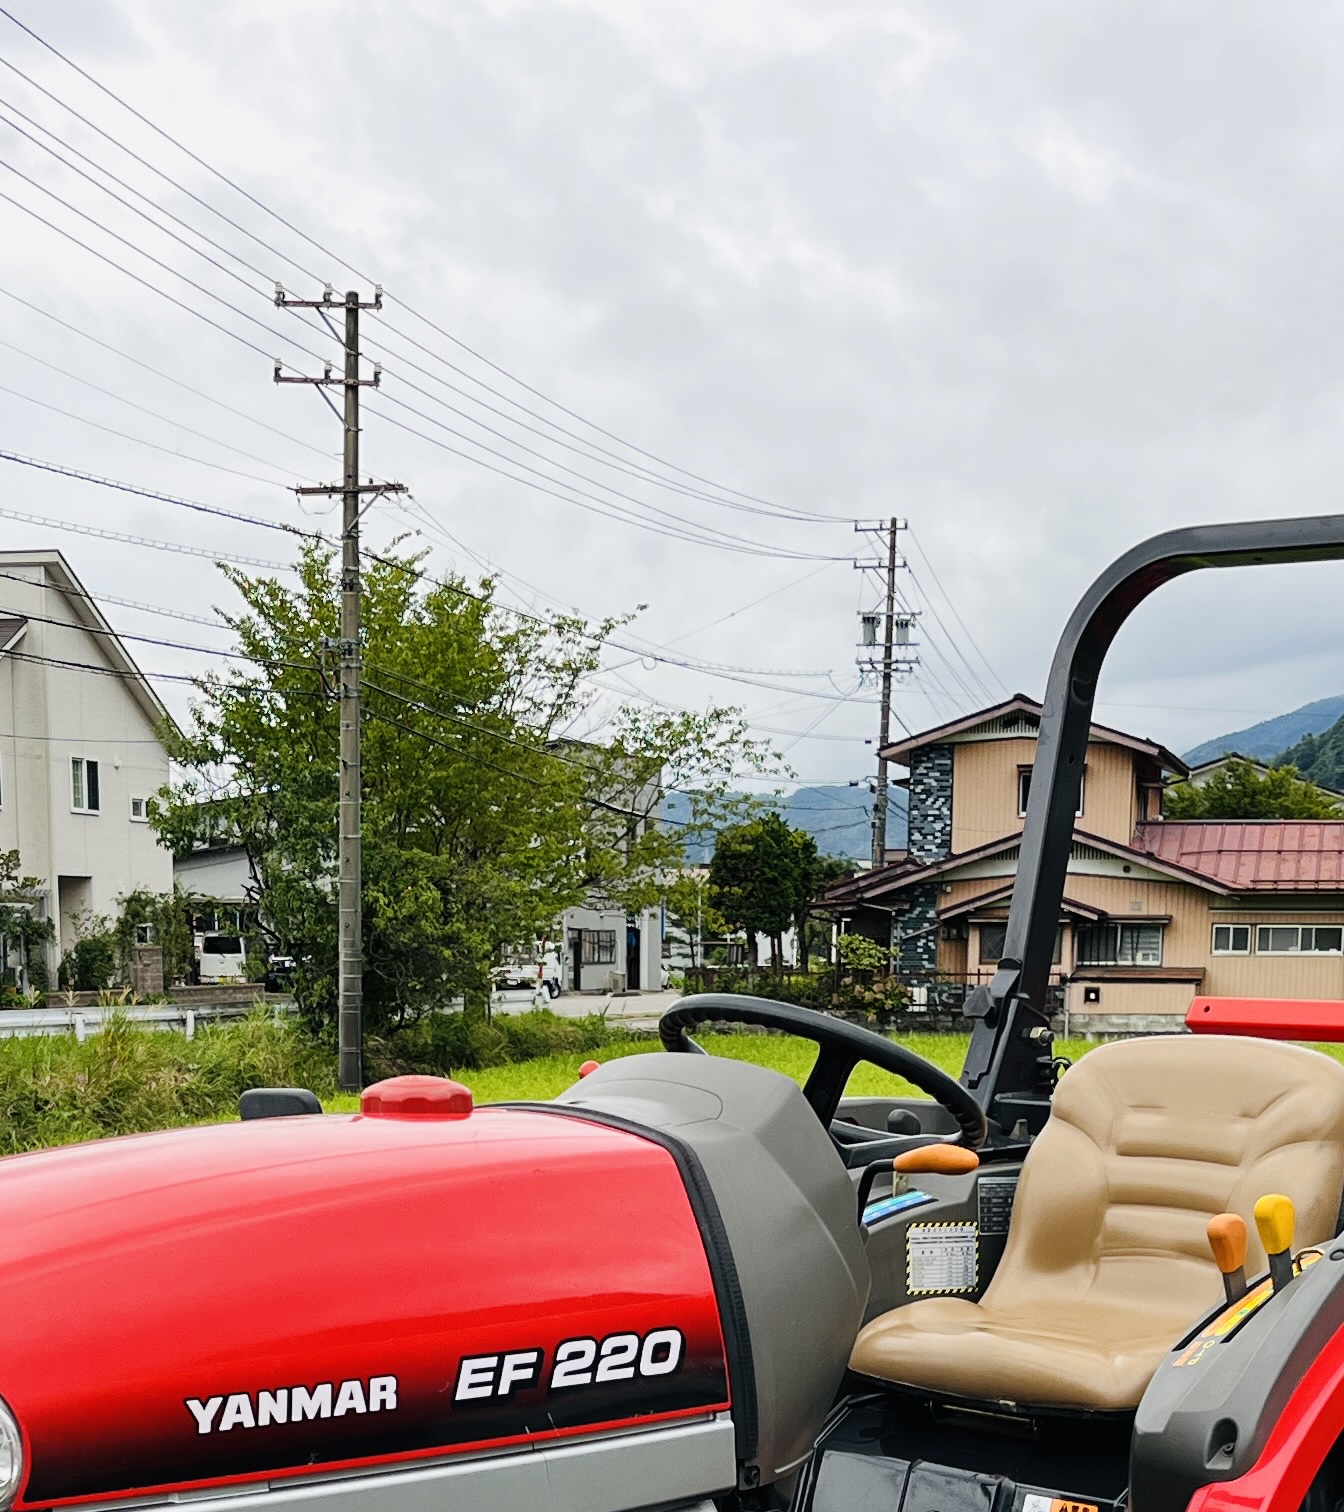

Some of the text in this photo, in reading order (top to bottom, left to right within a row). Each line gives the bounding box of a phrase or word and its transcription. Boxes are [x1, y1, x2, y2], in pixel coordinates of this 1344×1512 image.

[186, 1328, 683, 1435] YANMAR EF 220
